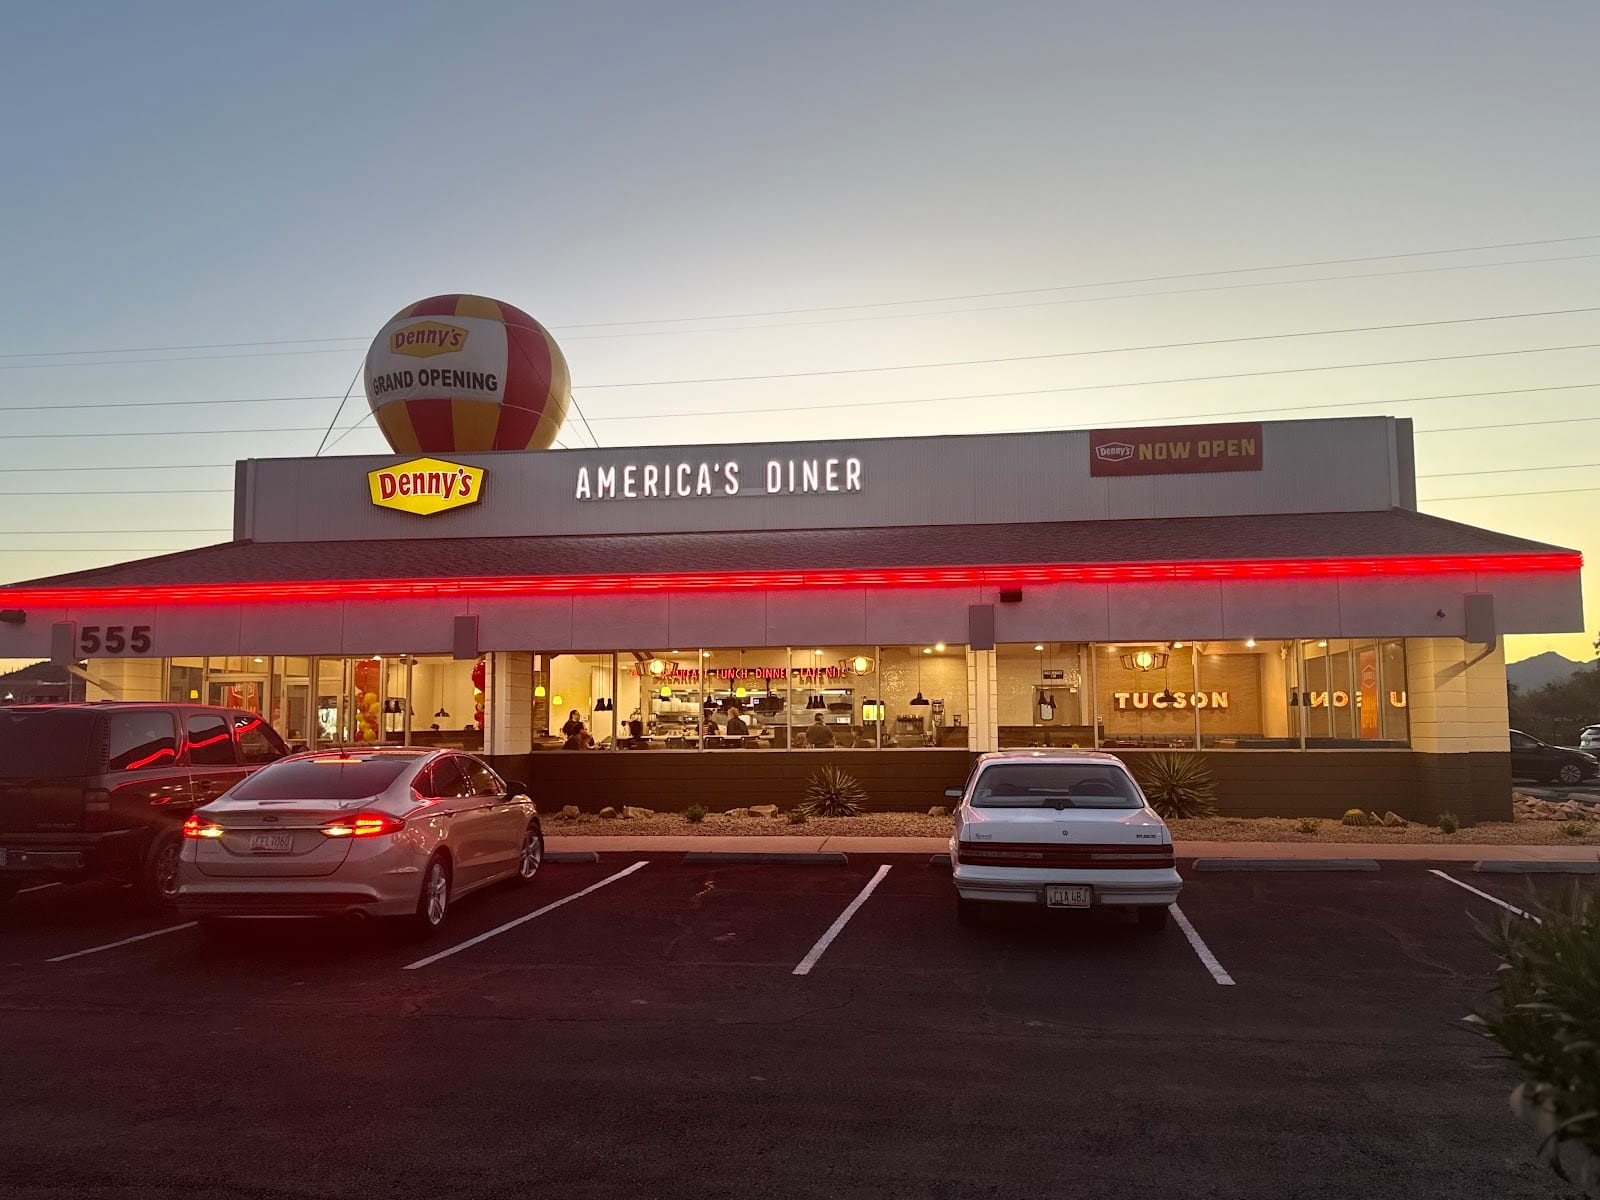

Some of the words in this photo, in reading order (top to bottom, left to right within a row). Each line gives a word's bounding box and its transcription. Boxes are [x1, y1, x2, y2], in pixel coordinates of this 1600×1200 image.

[395, 328, 463, 349] Denny's
[373, 370, 414, 396] GRAND
[418, 369, 498, 392] OPENING
[1100, 446, 1131, 457] Denny's
[1138, 441, 1191, 461] NOW
[1198, 438, 1255, 458] OPEN
[378, 468, 473, 500] Denny's
[575, 461, 739, 499] AMERICA'S
[766, 458, 861, 493] DINER
[81, 626, 151, 653] 555
[716, 668, 748, 679] LUNCH
[800, 667, 822, 678] LATE
[1114, 691, 1228, 709] TUCSON
